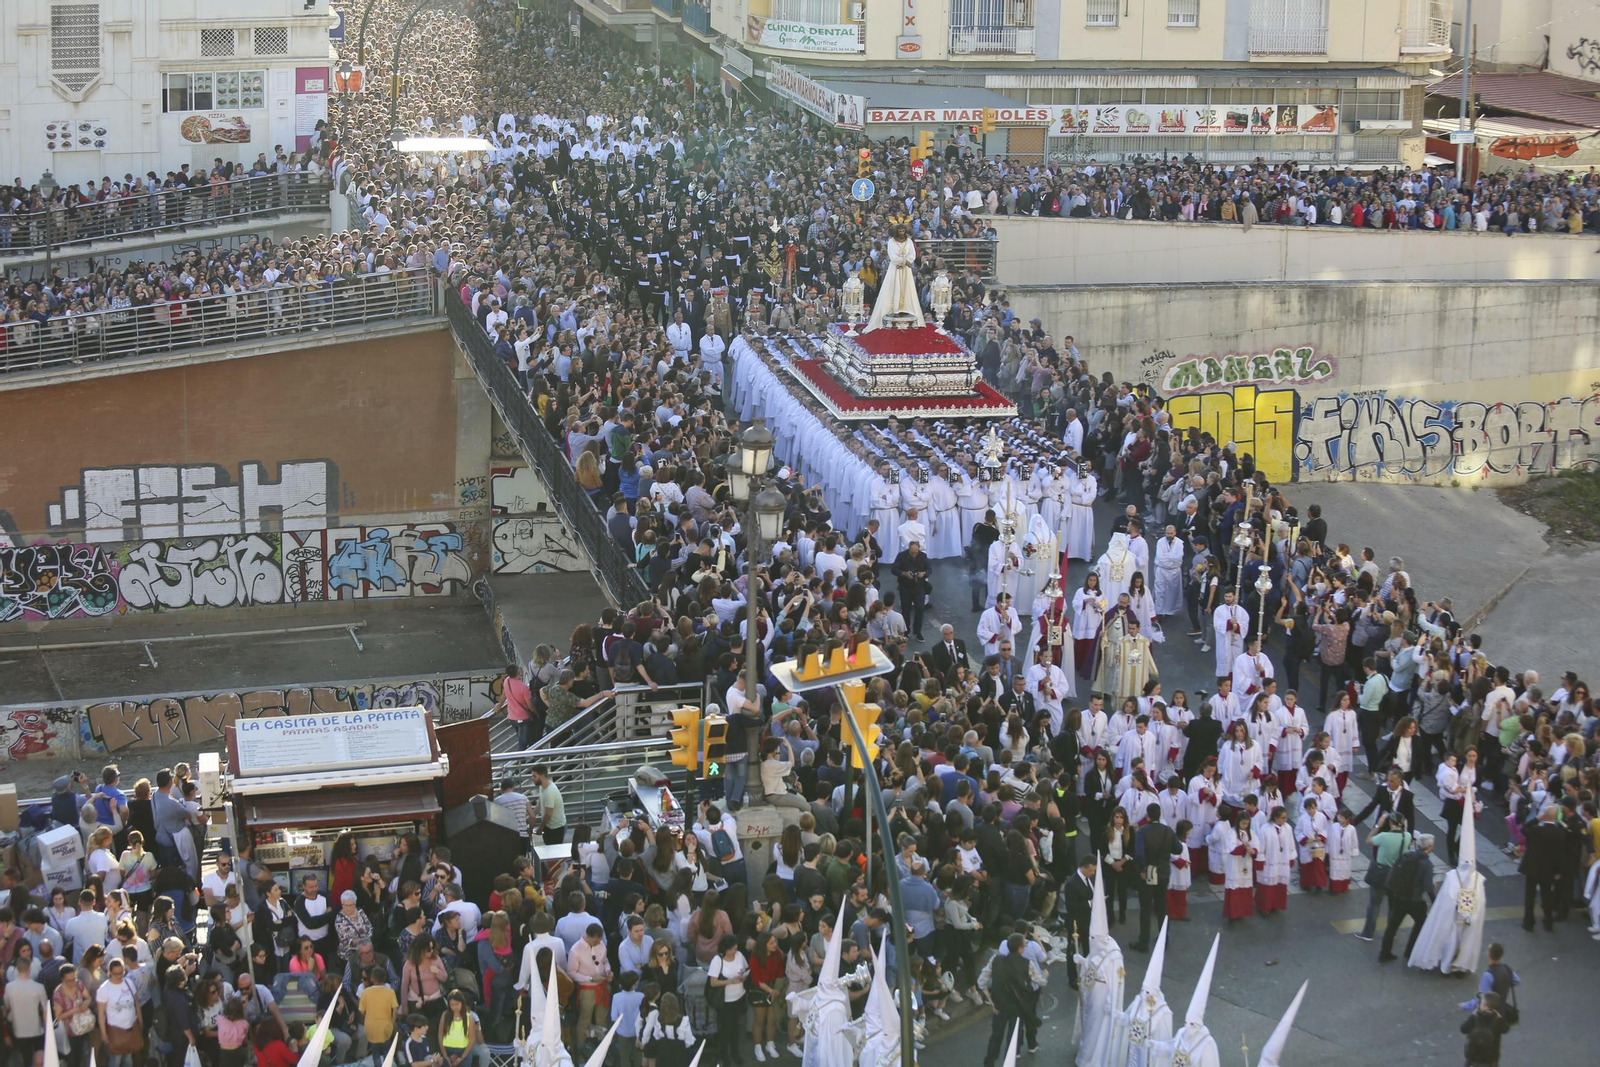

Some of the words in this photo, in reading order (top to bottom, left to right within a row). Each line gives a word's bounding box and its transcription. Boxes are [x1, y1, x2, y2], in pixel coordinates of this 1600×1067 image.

[767, 22, 806, 35] CLÍNICA
[809, 28, 855, 36] DENTAL
[871, 110, 936, 122] BAZAR
[242, 722, 260, 731] LA
[264, 718, 317, 730] CASITA
[322, 716, 340, 726] DE
[344, 714, 363, 724] LA
[368, 710, 420, 722] PATATA
[282, 727, 330, 736] PATATAS
[333, 723, 379, 732] ASADAS
